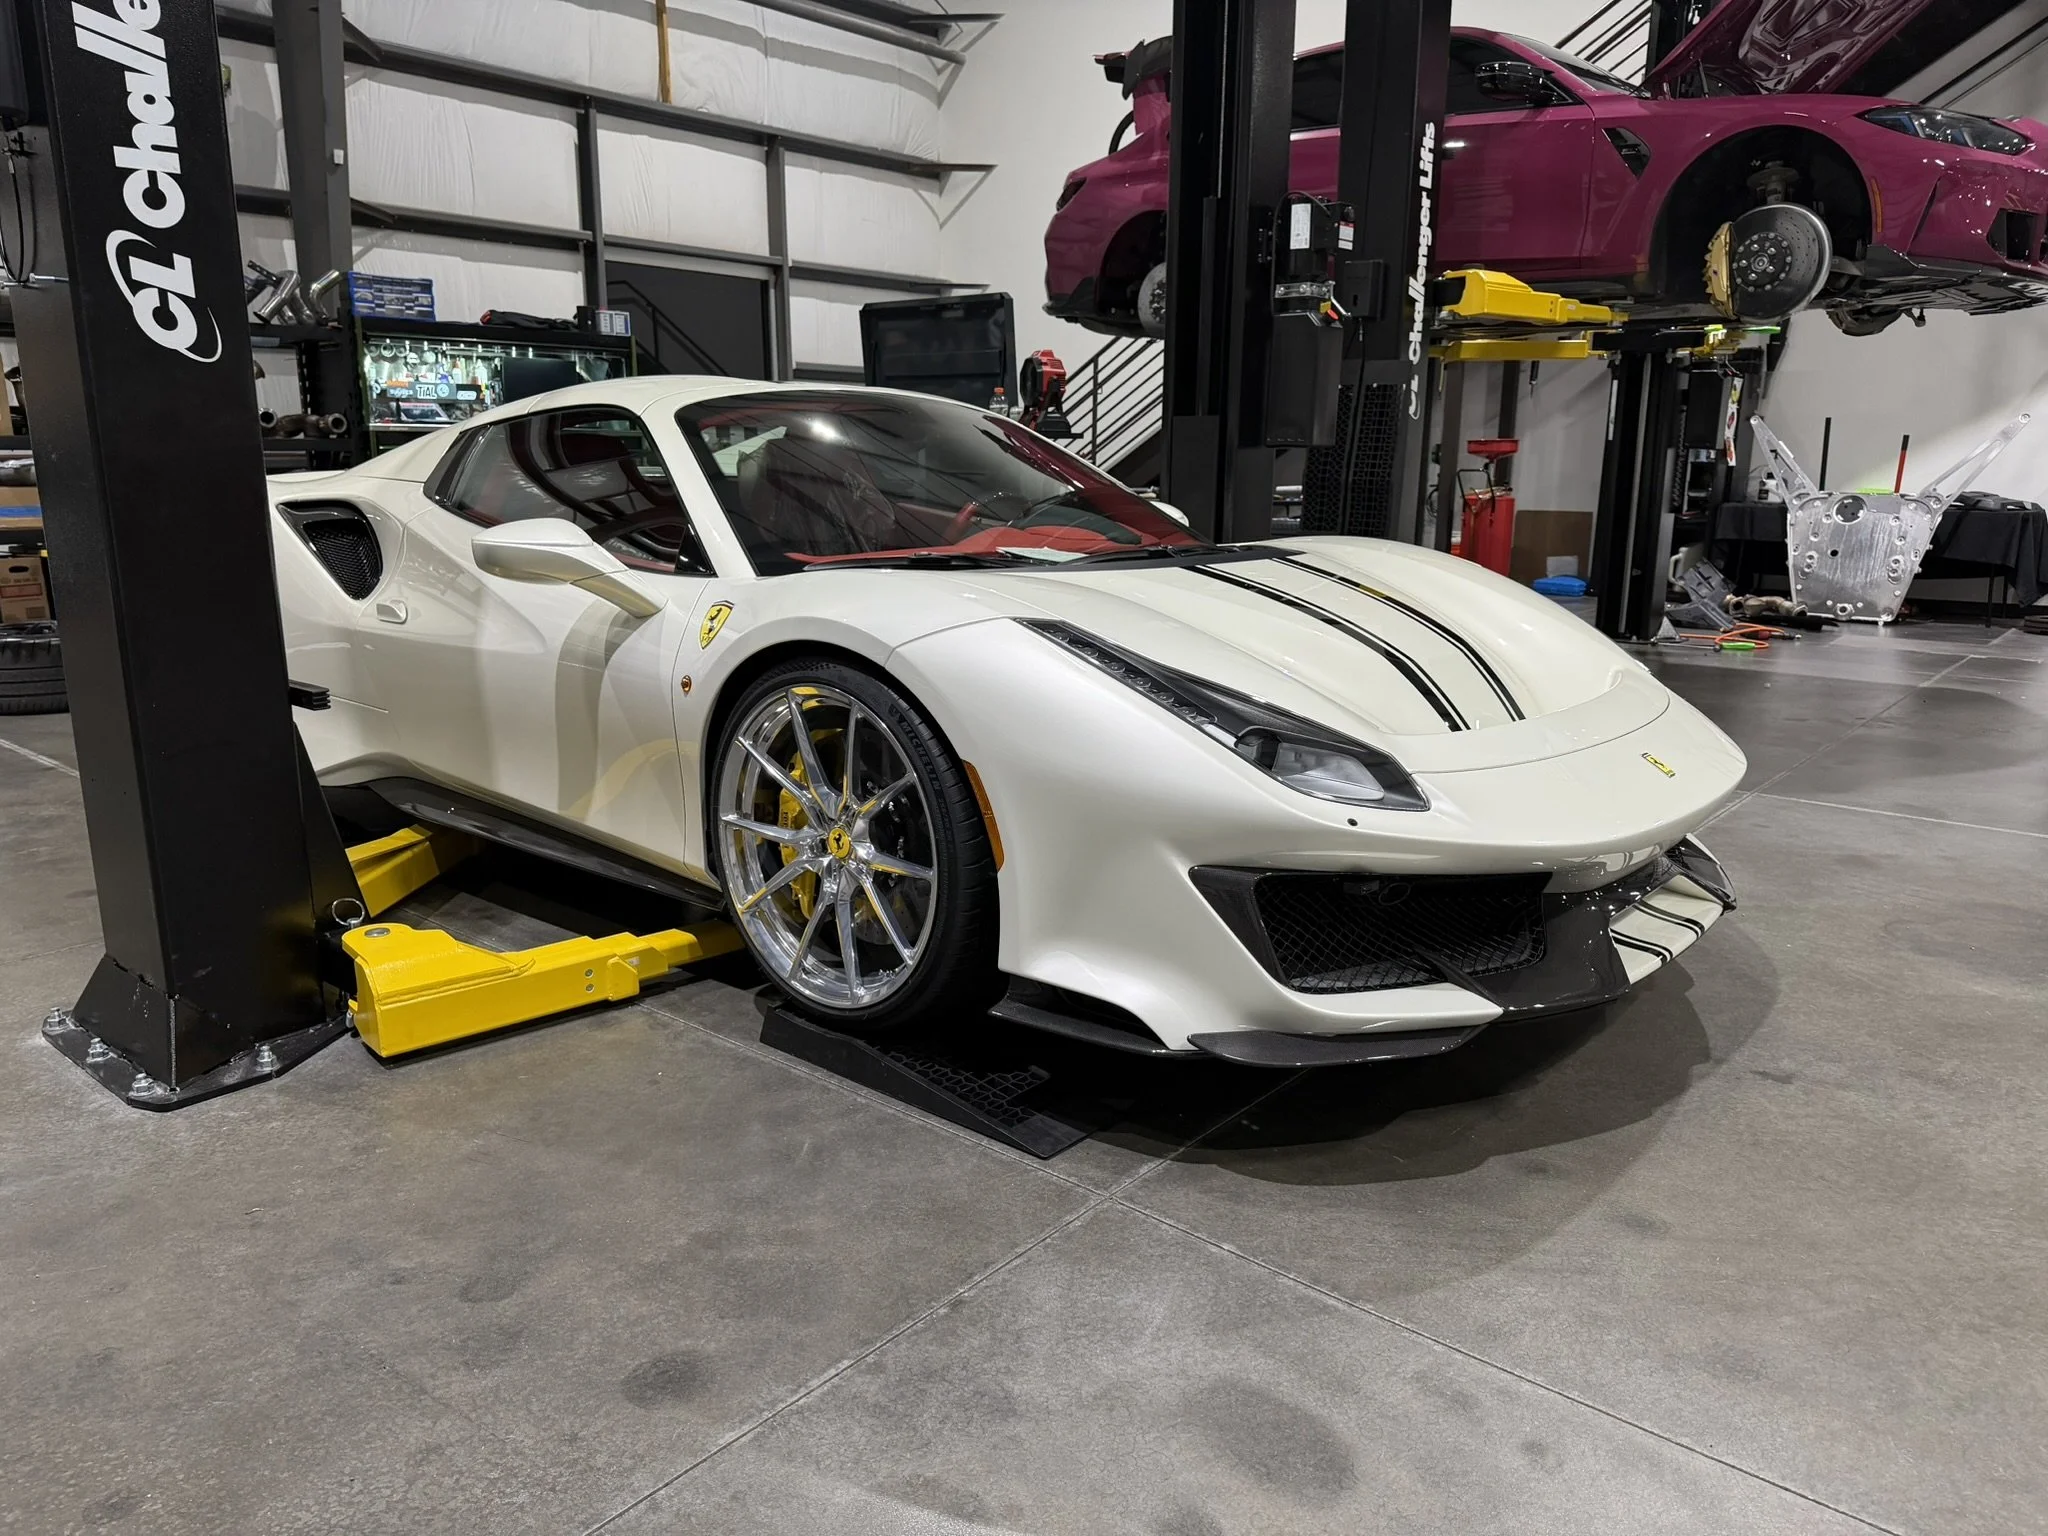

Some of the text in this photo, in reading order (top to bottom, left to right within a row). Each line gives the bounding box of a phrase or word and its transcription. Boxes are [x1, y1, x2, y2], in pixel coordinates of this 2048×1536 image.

[1419, 121, 1436, 190] Lifts
[1408, 191, 1433, 365] Challenger
[900, 720, 941, 791] MICHELIN
